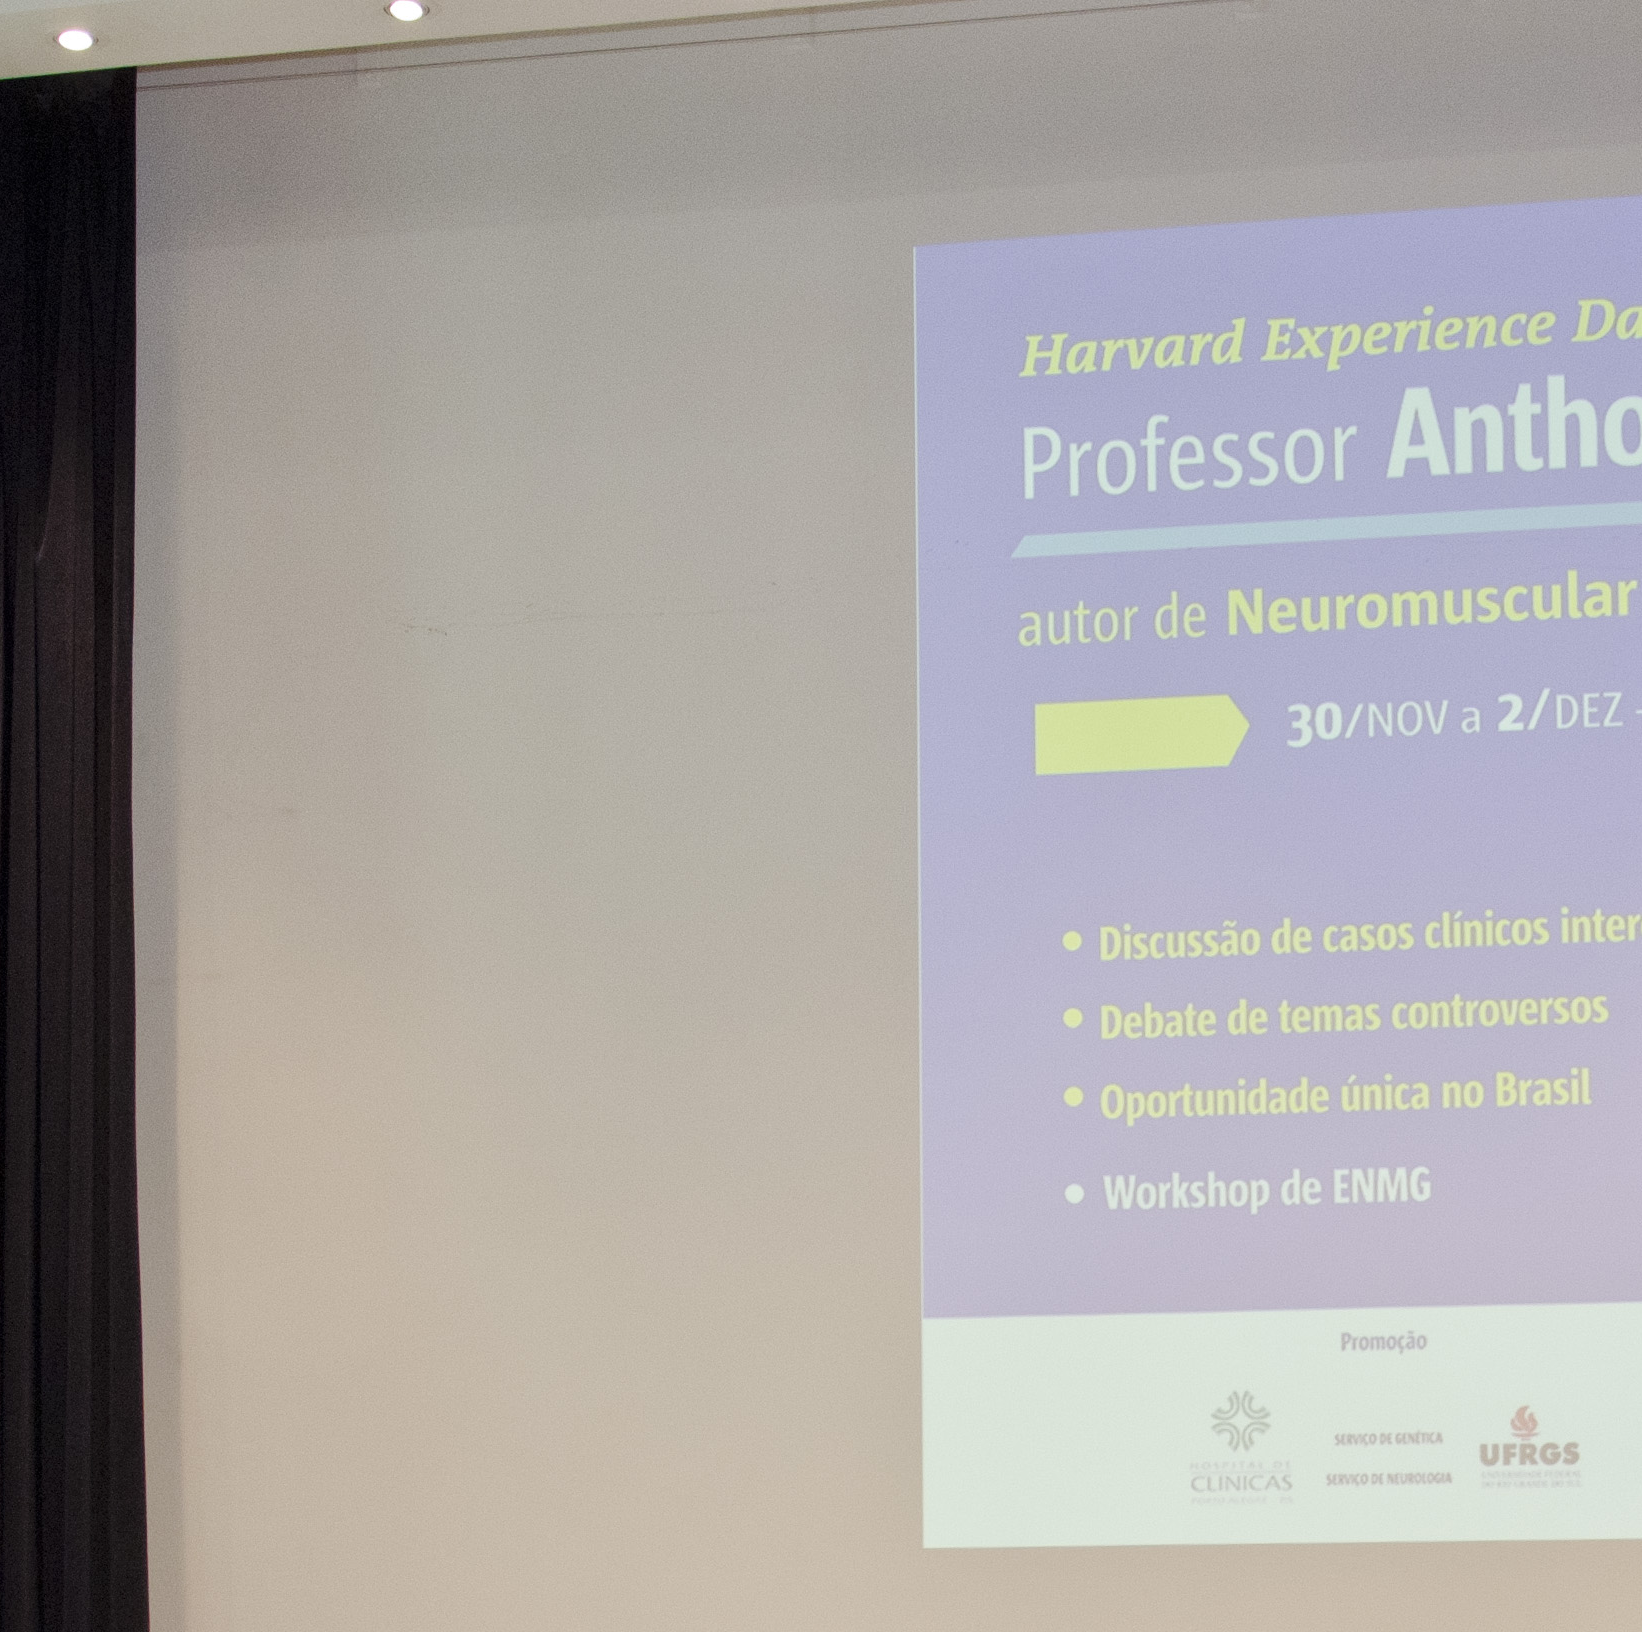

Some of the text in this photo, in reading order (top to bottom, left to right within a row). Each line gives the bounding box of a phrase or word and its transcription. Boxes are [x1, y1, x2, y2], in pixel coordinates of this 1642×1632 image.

[1020, 318, 1246, 377] Harvard
[1261, 306, 1556, 371] Experience
[1024, 415, 1357, 499] Professor
[1018, 601, 1138, 647] autor
[1154, 591, 1206, 639] de
[1228, 570, 1637, 635] Neuromuscular
[1287, 700, 1448, 748] 30/NOV
[1461, 707, 1480, 733] a
[1498, 688, 1622, 731] 2/DEZ
[1100, 920, 1261, 961] Discussão
[1271, 918, 1312, 954] de
[1323, 922, 1415, 953] casos
[1425, 910, 1550, 948] clínicos
[1101, 994, 1609, 1039] Debate de temas controversos
[1100, 1068, 1591, 1127] Oportunidade única no Brasil
[1104, 1166, 1431, 1214] Workshop de ENMG
[1341, 1330, 1428, 1354] Promoção
[1335, 1430, 1443, 1446] SERVIÇO DE GENÉTICA
[1480, 1442, 1580, 1467] UFRGS
[1326, 1472, 1452, 1486] SERVIÇO DE NEUROLOGIA
